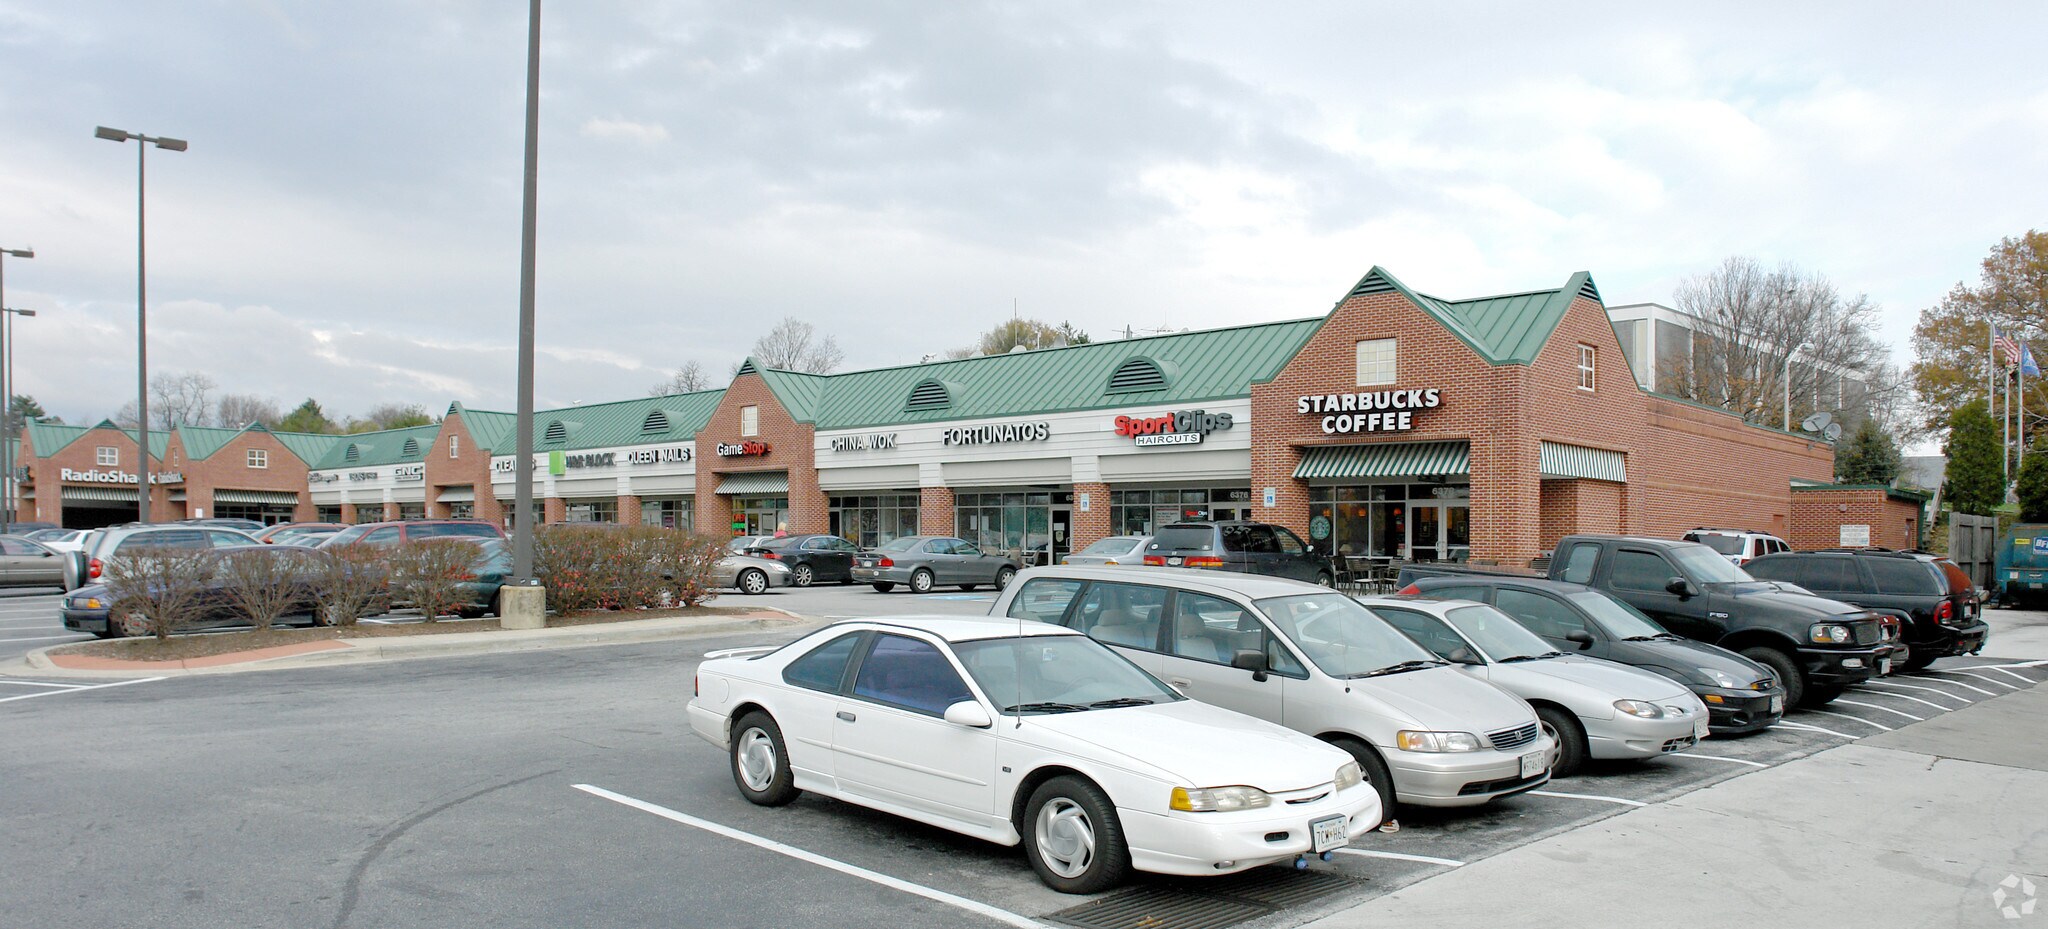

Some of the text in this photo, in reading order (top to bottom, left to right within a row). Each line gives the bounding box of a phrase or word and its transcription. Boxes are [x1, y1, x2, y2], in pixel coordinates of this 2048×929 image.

[1298, 389, 1440, 414] STARBUCKS
[1321, 411, 1412, 434] COFFEE
[942, 421, 1049, 446] FORTUNATOS
[1137, 434, 1198, 445] HAIRCUTS
[716, 441, 767, 456] GameStop
[830, 433, 898, 451] CHINA WOK
[585, 452, 616, 467] BLOCK
[627, 447, 692, 464] QUEEN NAILS
[61, 468, 157, 484] RadioShak
[394, 466, 423, 476] GNC
